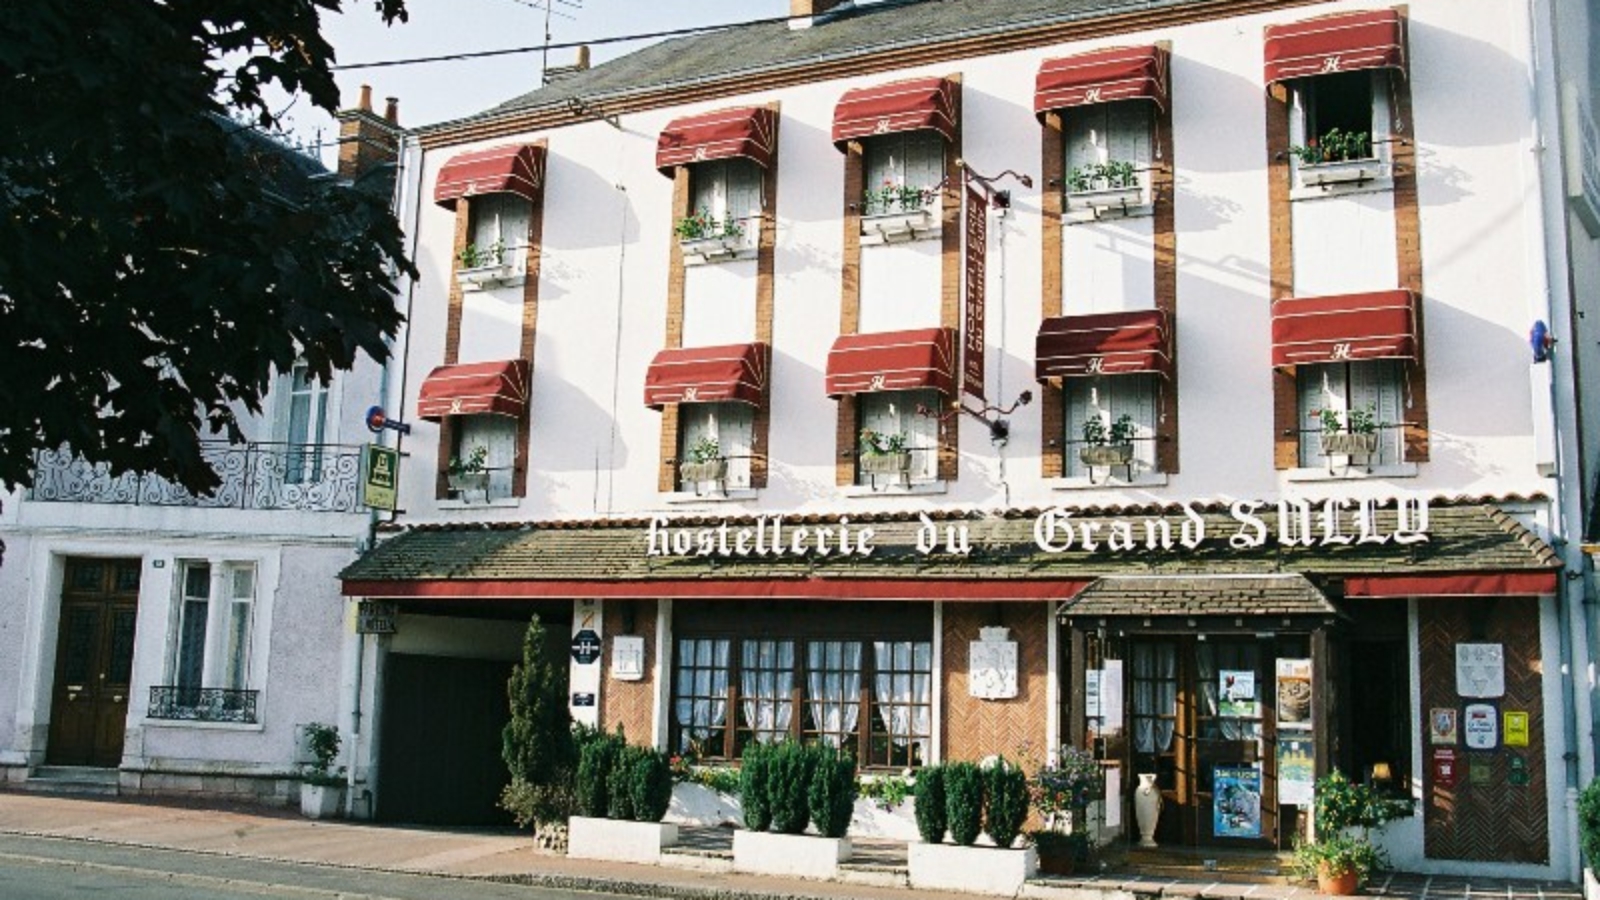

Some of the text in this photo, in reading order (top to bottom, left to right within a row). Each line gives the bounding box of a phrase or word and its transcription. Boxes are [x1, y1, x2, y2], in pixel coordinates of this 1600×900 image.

[1322, 56, 1340, 72] H
[967, 201, 977, 350] HOSTELLERIE
[976, 259, 984, 321] Grand
[1331, 344, 1350, 359] H
[915, 511, 973, 555] du
[1033, 502, 1206, 553] Grand
[1228, 496, 1430, 549] SULLY
